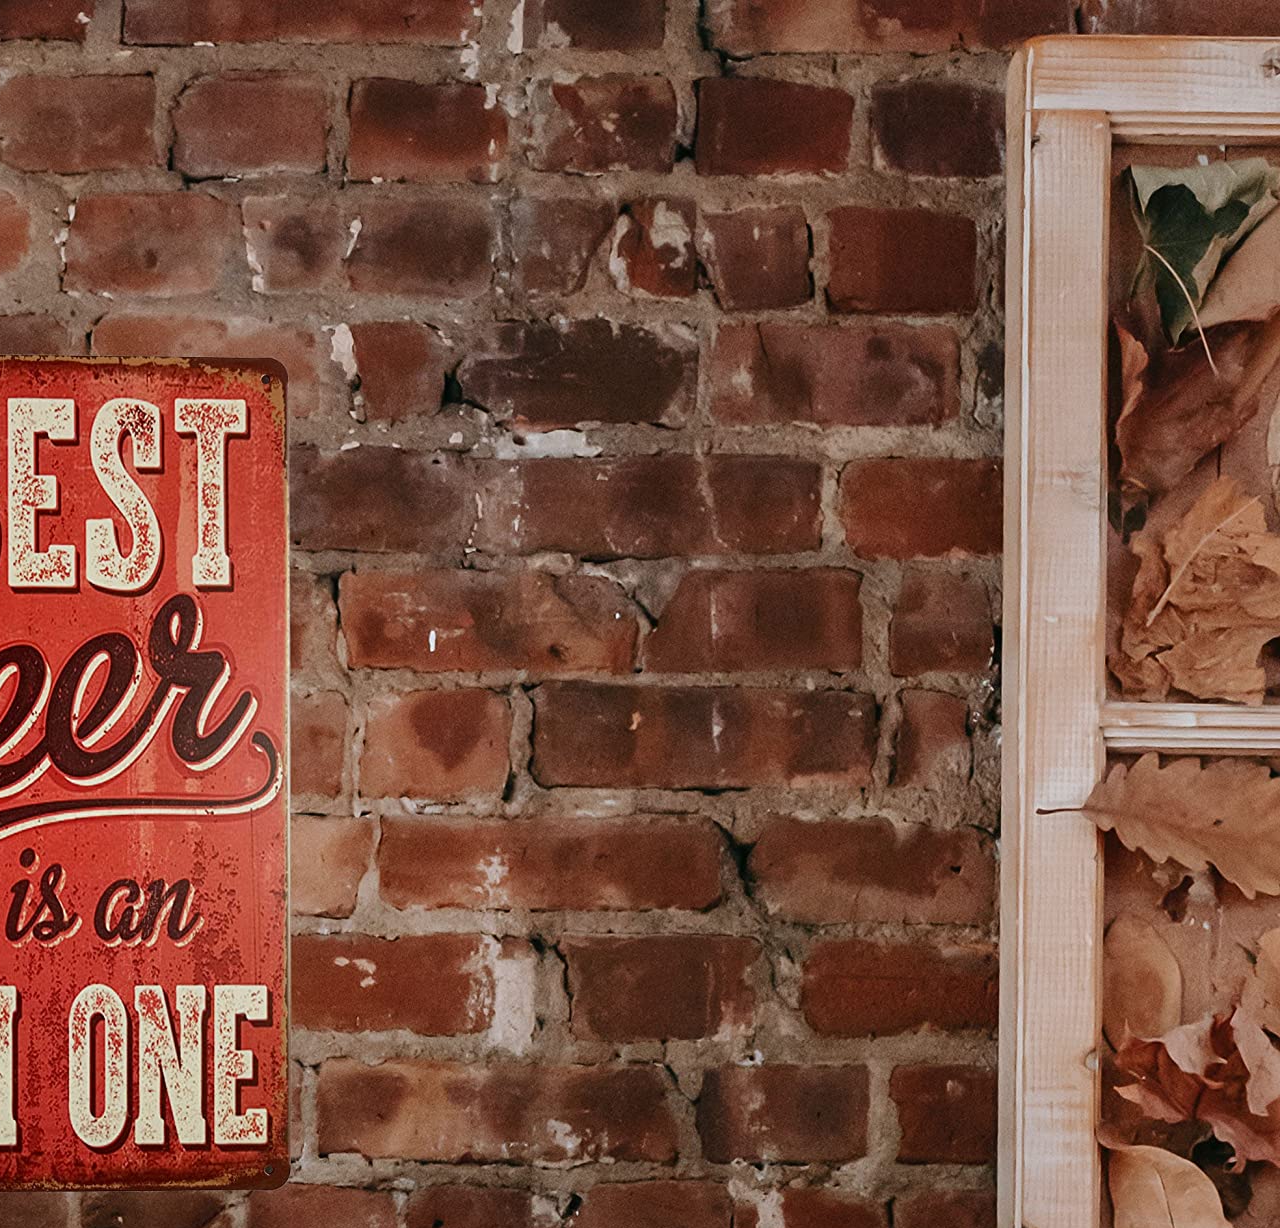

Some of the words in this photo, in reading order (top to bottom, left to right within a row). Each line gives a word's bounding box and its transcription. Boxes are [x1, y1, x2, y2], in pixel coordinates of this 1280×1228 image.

[5, 847, 82, 949] is
[93, 876, 205, 949] an
[68, 983, 269, 1149] ONE
